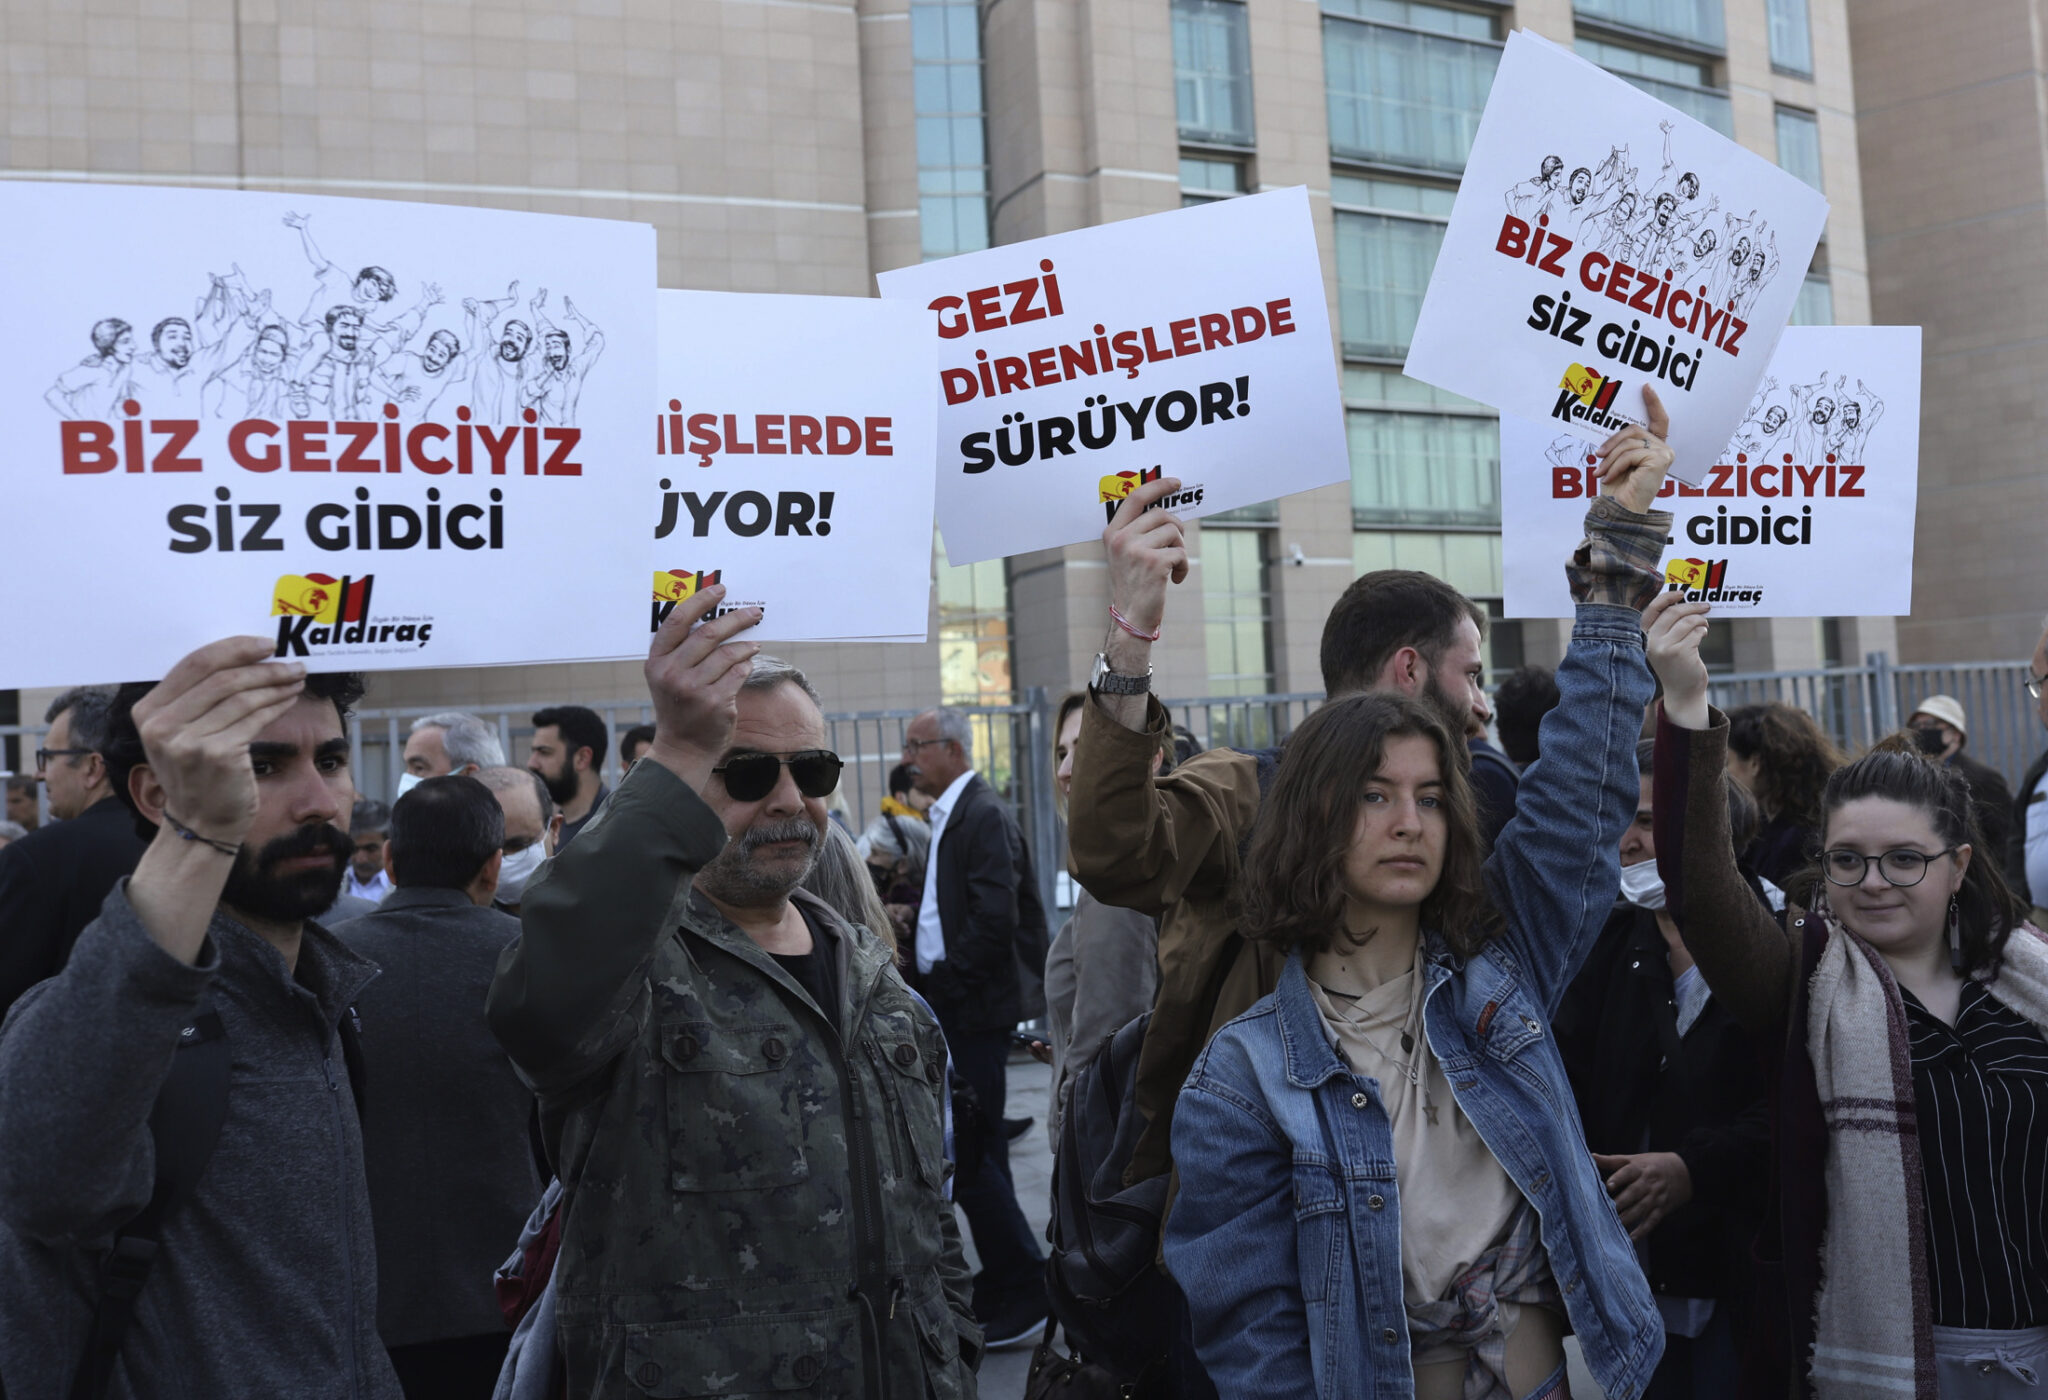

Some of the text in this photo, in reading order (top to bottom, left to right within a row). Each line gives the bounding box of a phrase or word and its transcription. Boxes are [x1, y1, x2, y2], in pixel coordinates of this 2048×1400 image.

[928, 259, 1064, 339] GEZİ
[1495, 214, 1748, 357] BİZ GEZİCİYİZ
[940, 298, 1296, 406] DİRENİŞLERDE
[1526, 291, 1703, 392] SİZ GİDİCİ
[60, 400, 583, 476] BİZ GEZİCİYİZ
[960, 376, 1251, 474] SÜRÜYOR!
[1551, 376, 1630, 431] Kaldır
[1552, 453, 1866, 498] Bİ ZİCİYİZ
[166, 487, 504, 554] SİZ GİDİCİ
[1686, 505, 1812, 545] GİDİCİ
[274, 574, 432, 657] Kaldıraç
